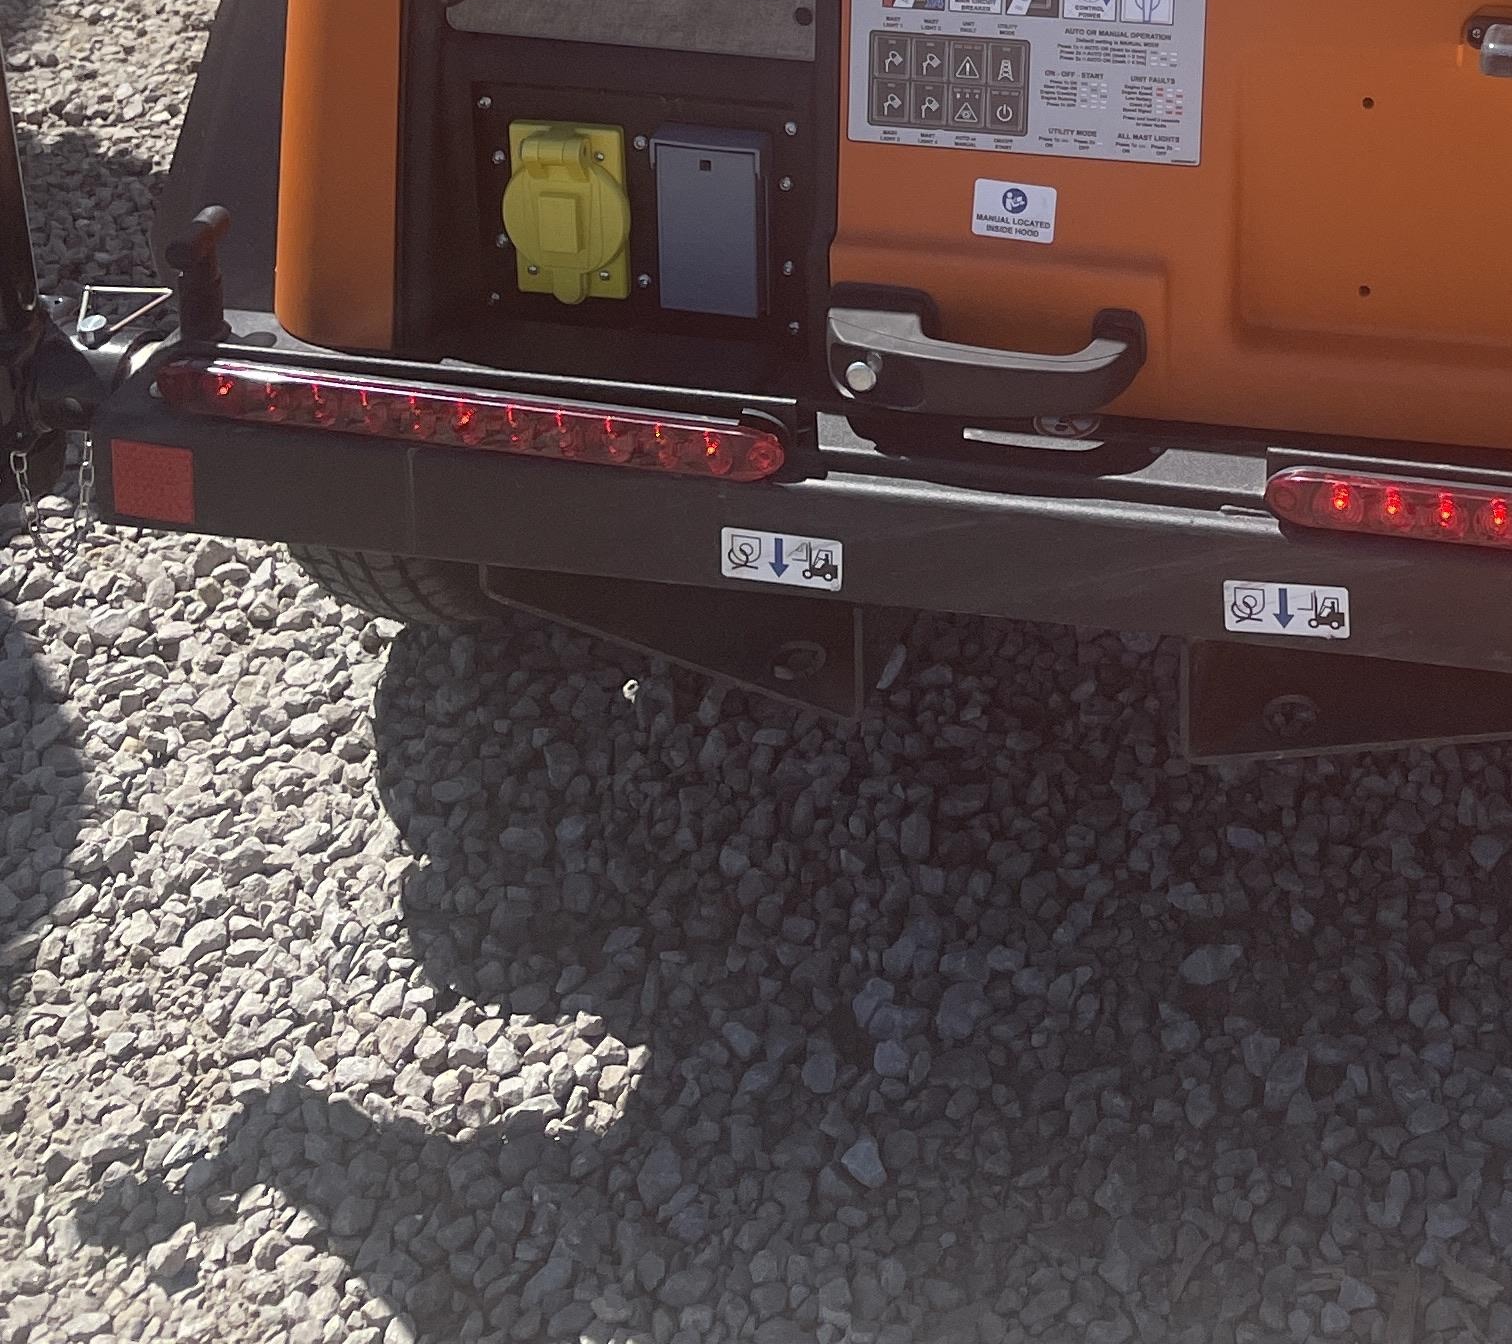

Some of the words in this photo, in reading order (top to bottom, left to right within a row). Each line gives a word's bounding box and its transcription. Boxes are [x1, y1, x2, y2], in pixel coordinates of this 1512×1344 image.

[976, 214, 1010, 224] MANUAL
[1012, 218, 1050, 229] LOCATED
[986, 224, 1013, 235] INSIDE
[1015, 228, 1039, 237] HOOD
